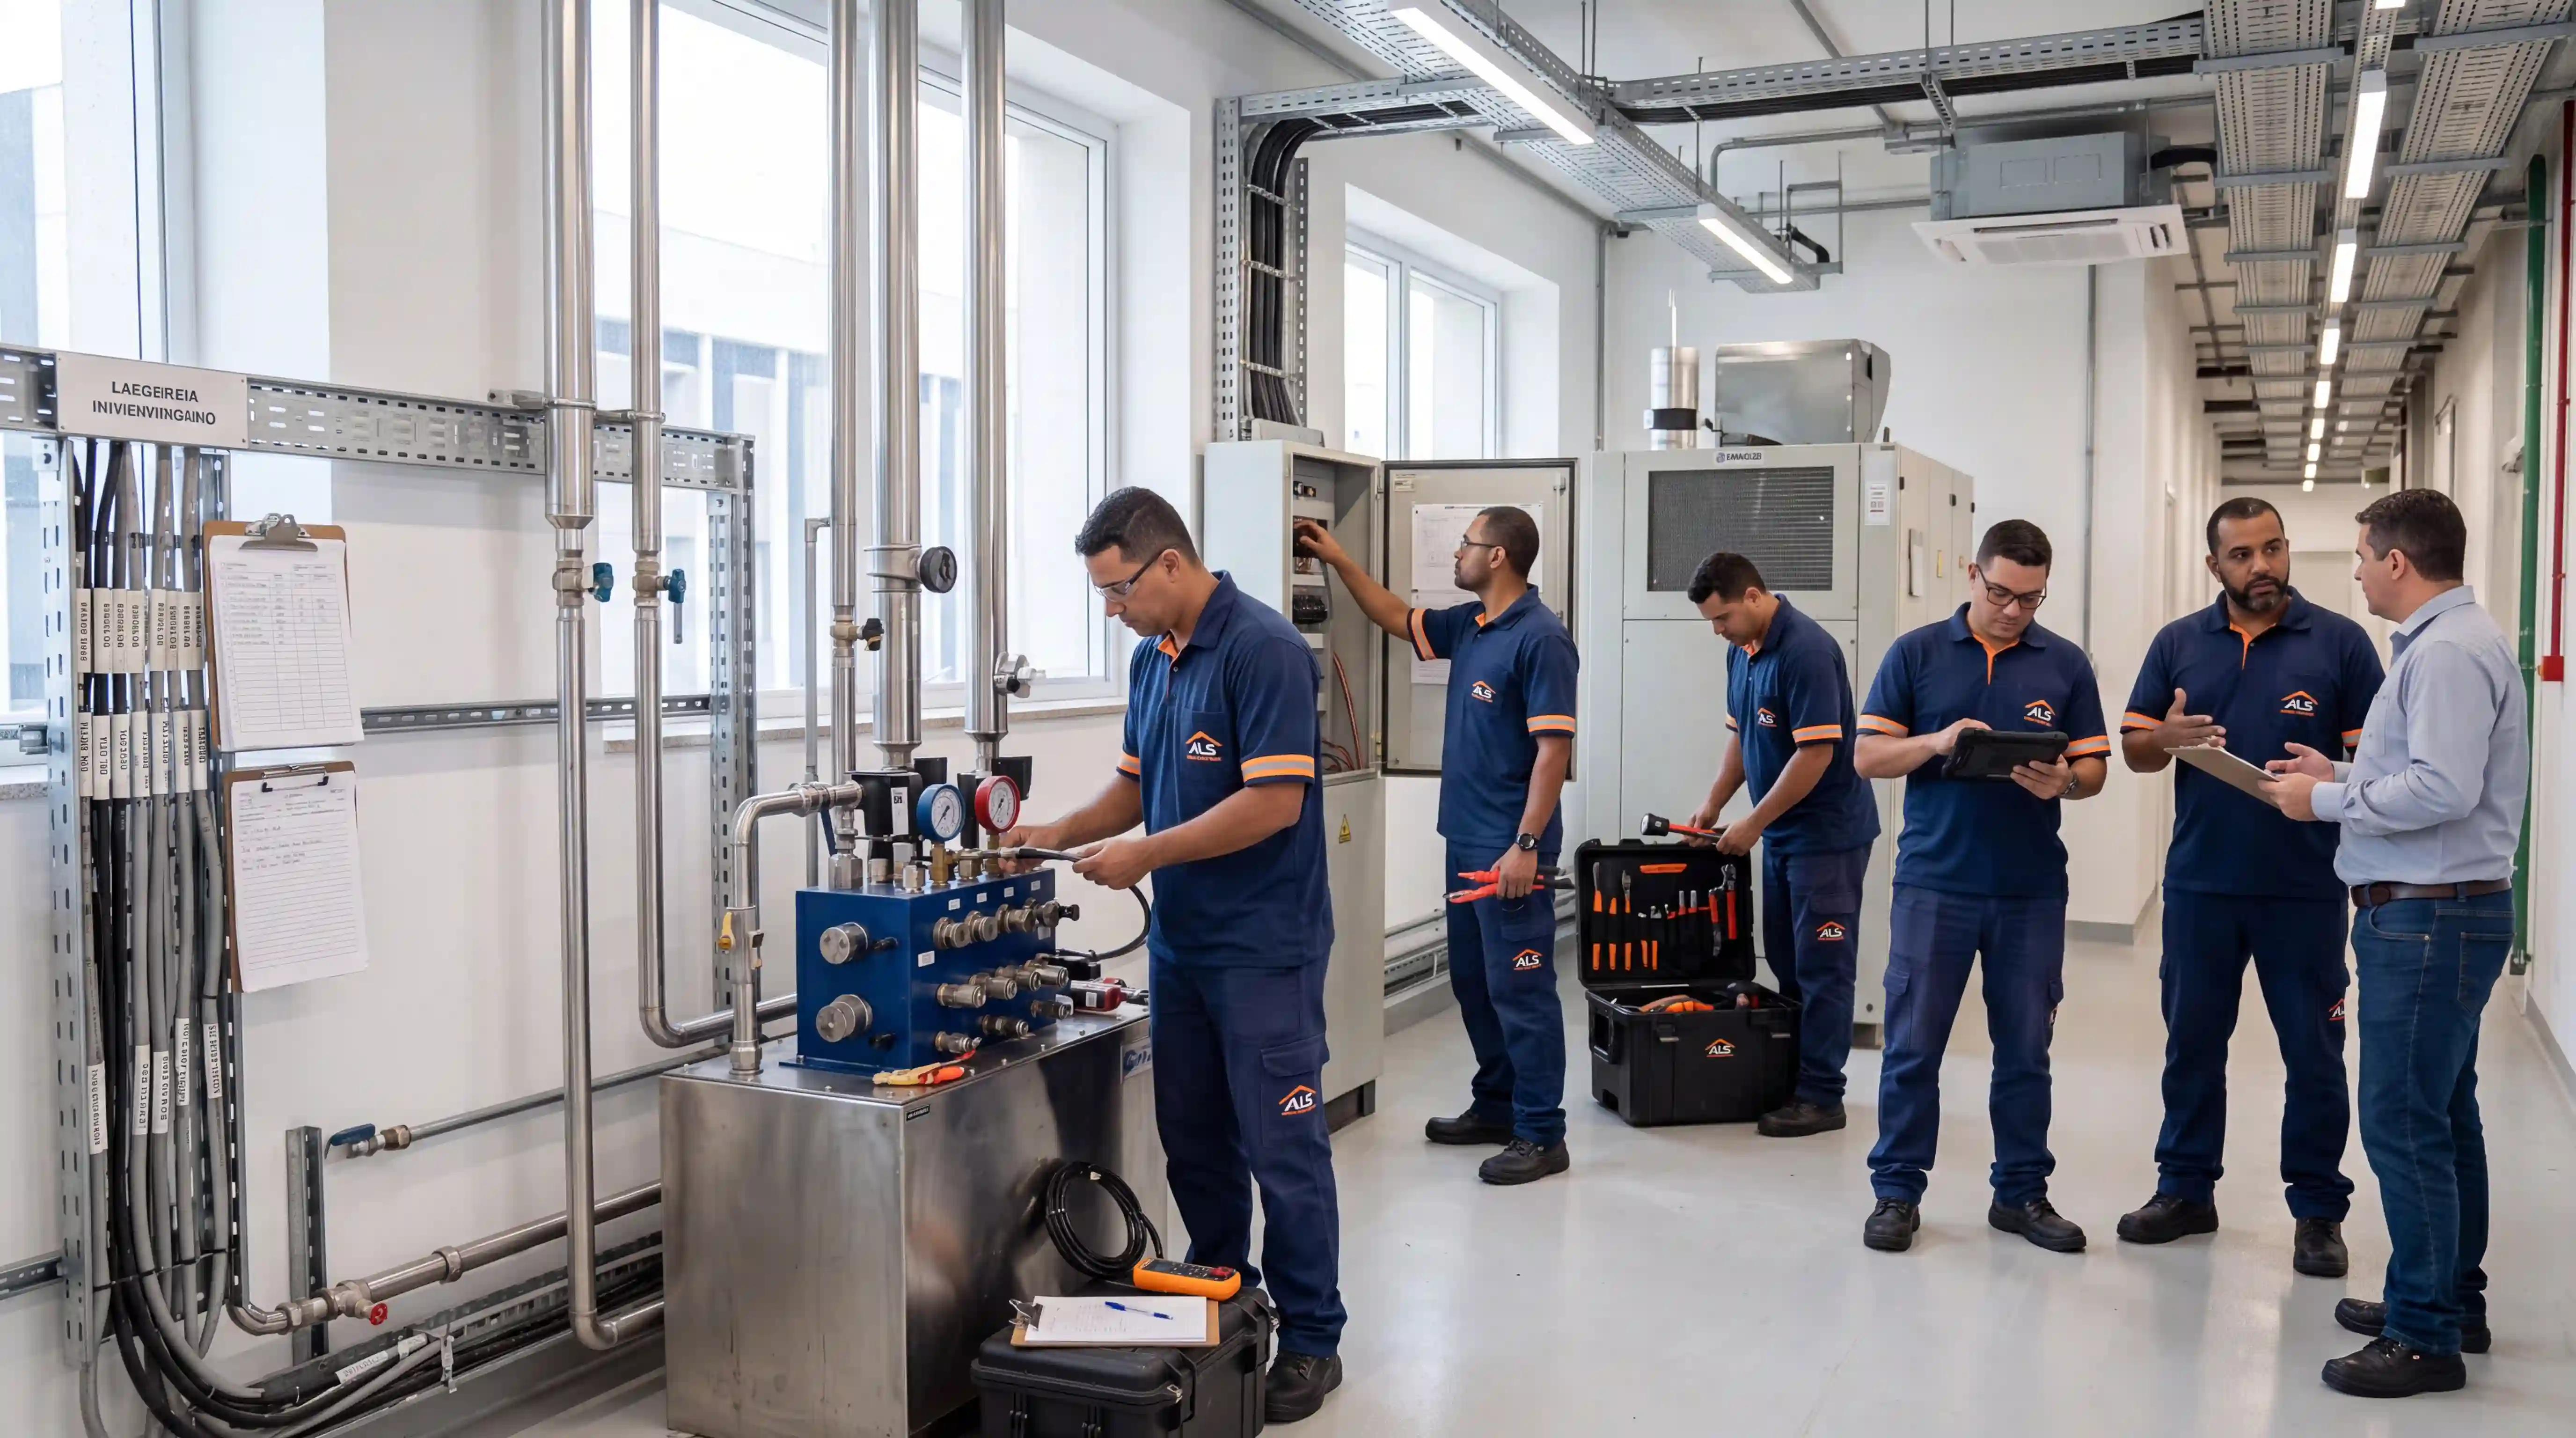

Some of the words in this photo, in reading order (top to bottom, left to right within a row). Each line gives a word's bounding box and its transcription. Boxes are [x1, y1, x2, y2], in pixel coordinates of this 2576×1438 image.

[2284, 698, 2313, 712] ALS
[2027, 707, 2052, 721] ALS
[1188, 741, 1217, 756] ALS
[1819, 928, 1843, 938] ALS
[1515, 954, 1540, 968] ALS
[1708, 1044, 1731, 1055] ALS
[1284, 1092, 1313, 1112] ALS
